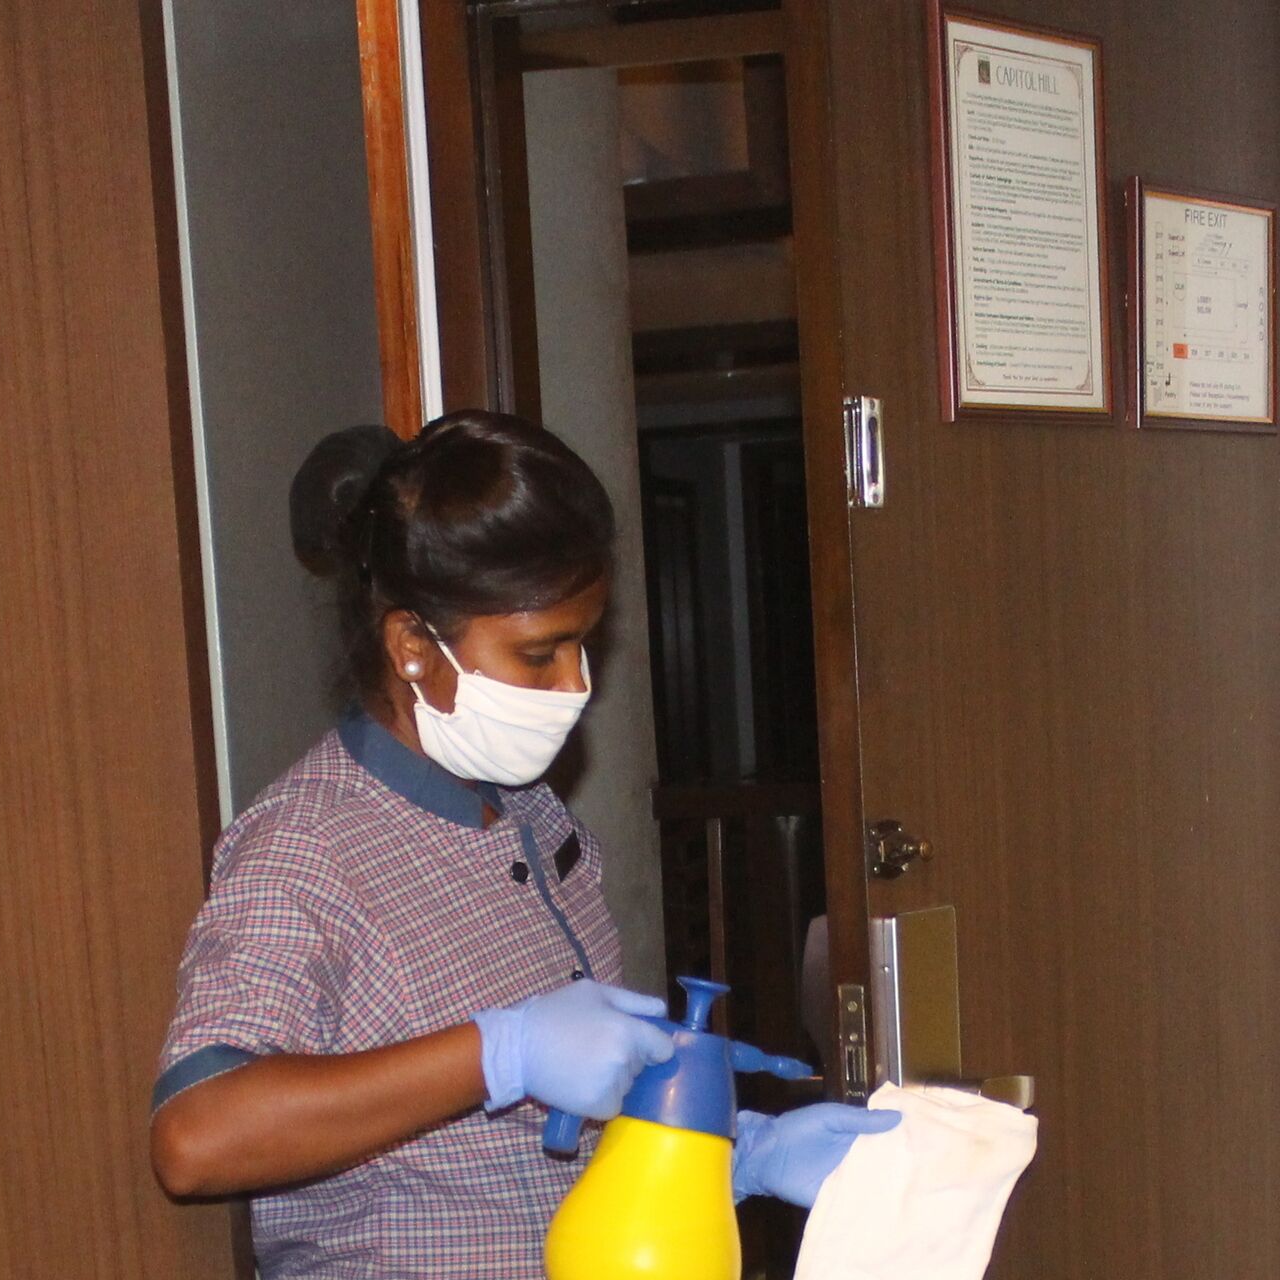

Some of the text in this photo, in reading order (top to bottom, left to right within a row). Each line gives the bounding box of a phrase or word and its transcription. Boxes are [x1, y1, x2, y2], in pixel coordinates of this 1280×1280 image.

[996, 66, 1060, 95] CAPITOL HILL
[1184, 208, 1228, 228] FIRE EXIT
